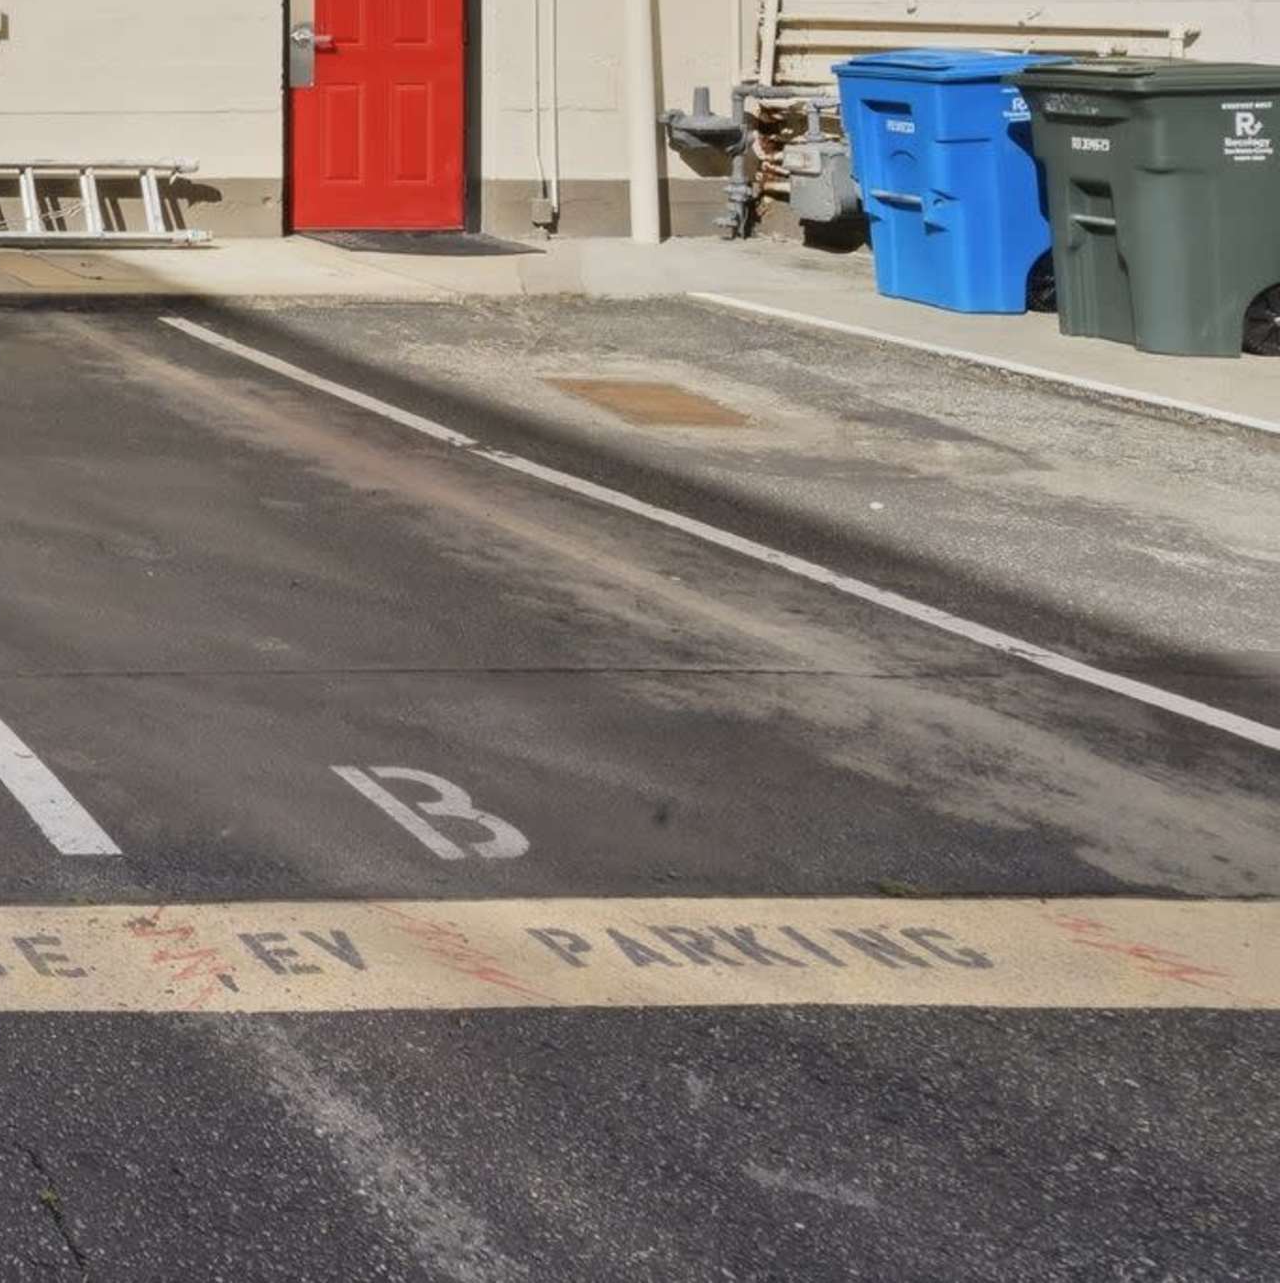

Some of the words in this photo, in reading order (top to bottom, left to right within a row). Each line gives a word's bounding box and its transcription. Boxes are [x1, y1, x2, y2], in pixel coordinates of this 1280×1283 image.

[328, 765, 531, 860] B
[237, 929, 368, 975] EV
[525, 924, 995, 969] PARKING
